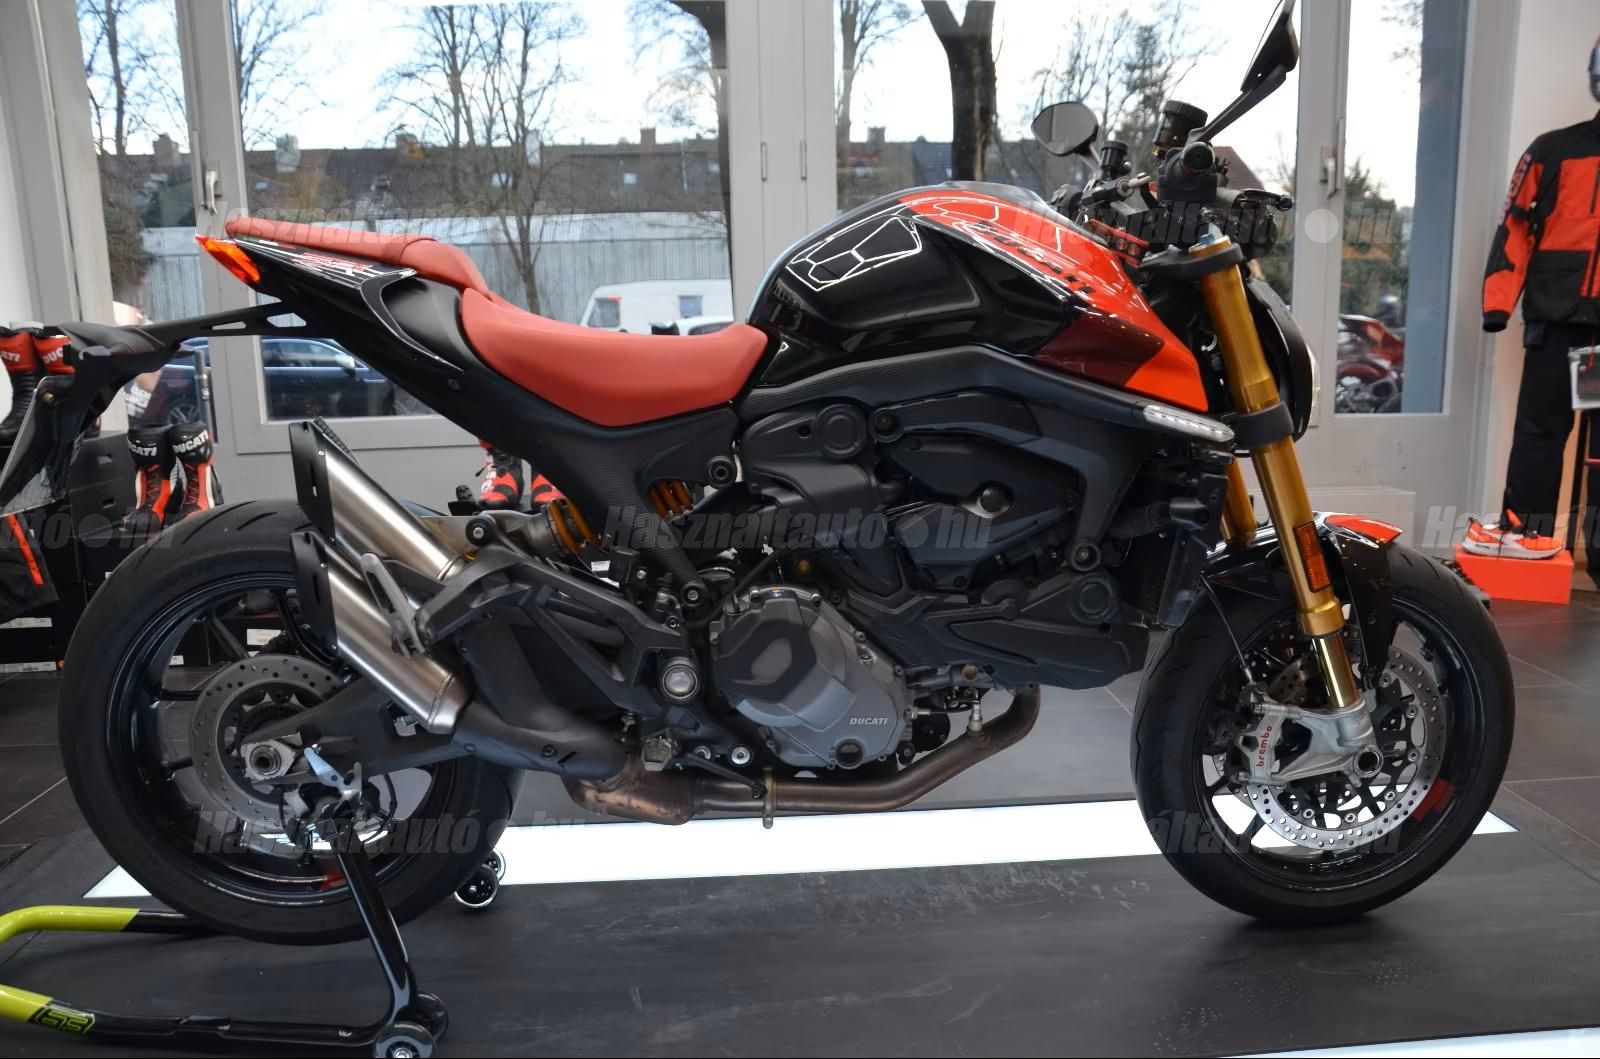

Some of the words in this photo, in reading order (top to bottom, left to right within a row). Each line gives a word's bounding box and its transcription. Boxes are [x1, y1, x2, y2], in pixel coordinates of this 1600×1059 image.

[172, 429, 209, 454] DUCATI
[849, 717, 888, 726] DUCATI
[1256, 725, 1273, 768] brembo
